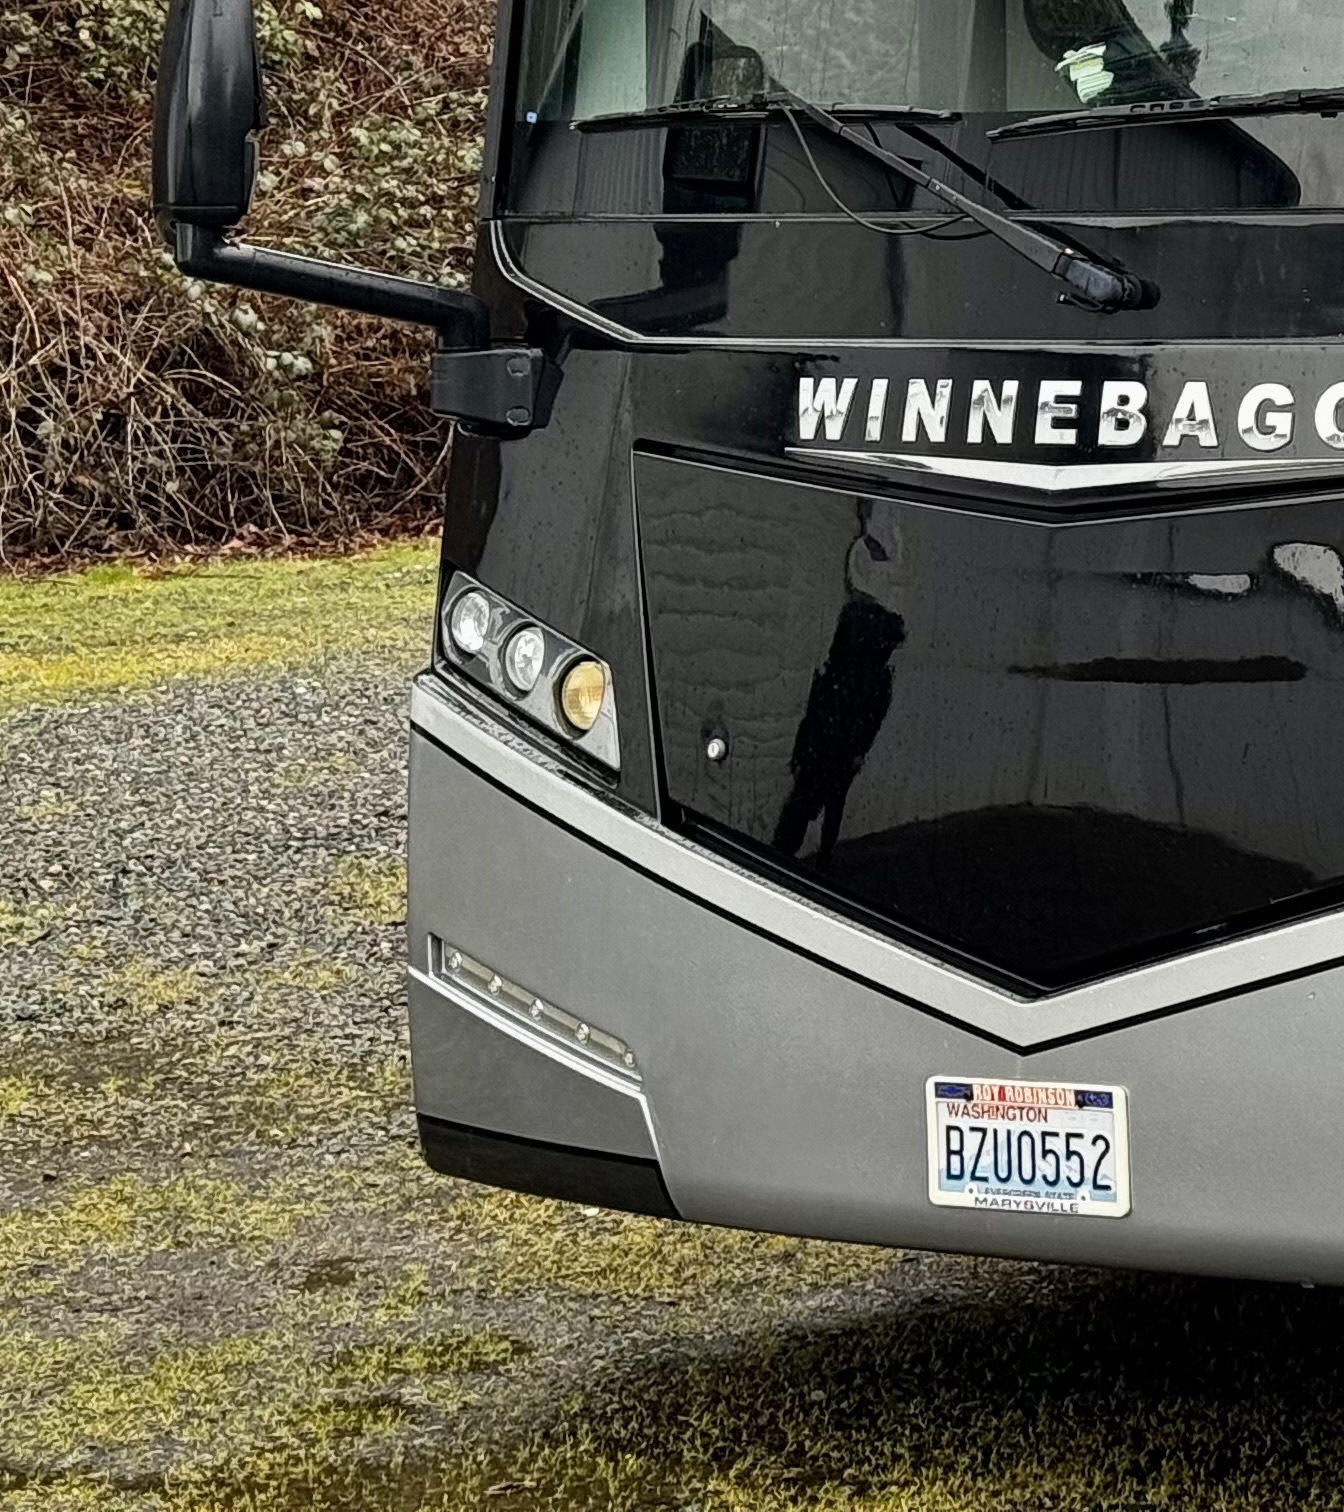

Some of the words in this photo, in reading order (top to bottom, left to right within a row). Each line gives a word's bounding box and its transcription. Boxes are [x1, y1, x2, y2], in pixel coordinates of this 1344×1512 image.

[972, 1083, 1000, 1101] ROY
[1005, 1086, 1076, 1107] ROBINSON
[947, 1101, 1048, 1123] WASHINGTON
[945, 1124, 1113, 1192] BZU0552
[974, 1196, 1080, 1214] MARYSVILLE
